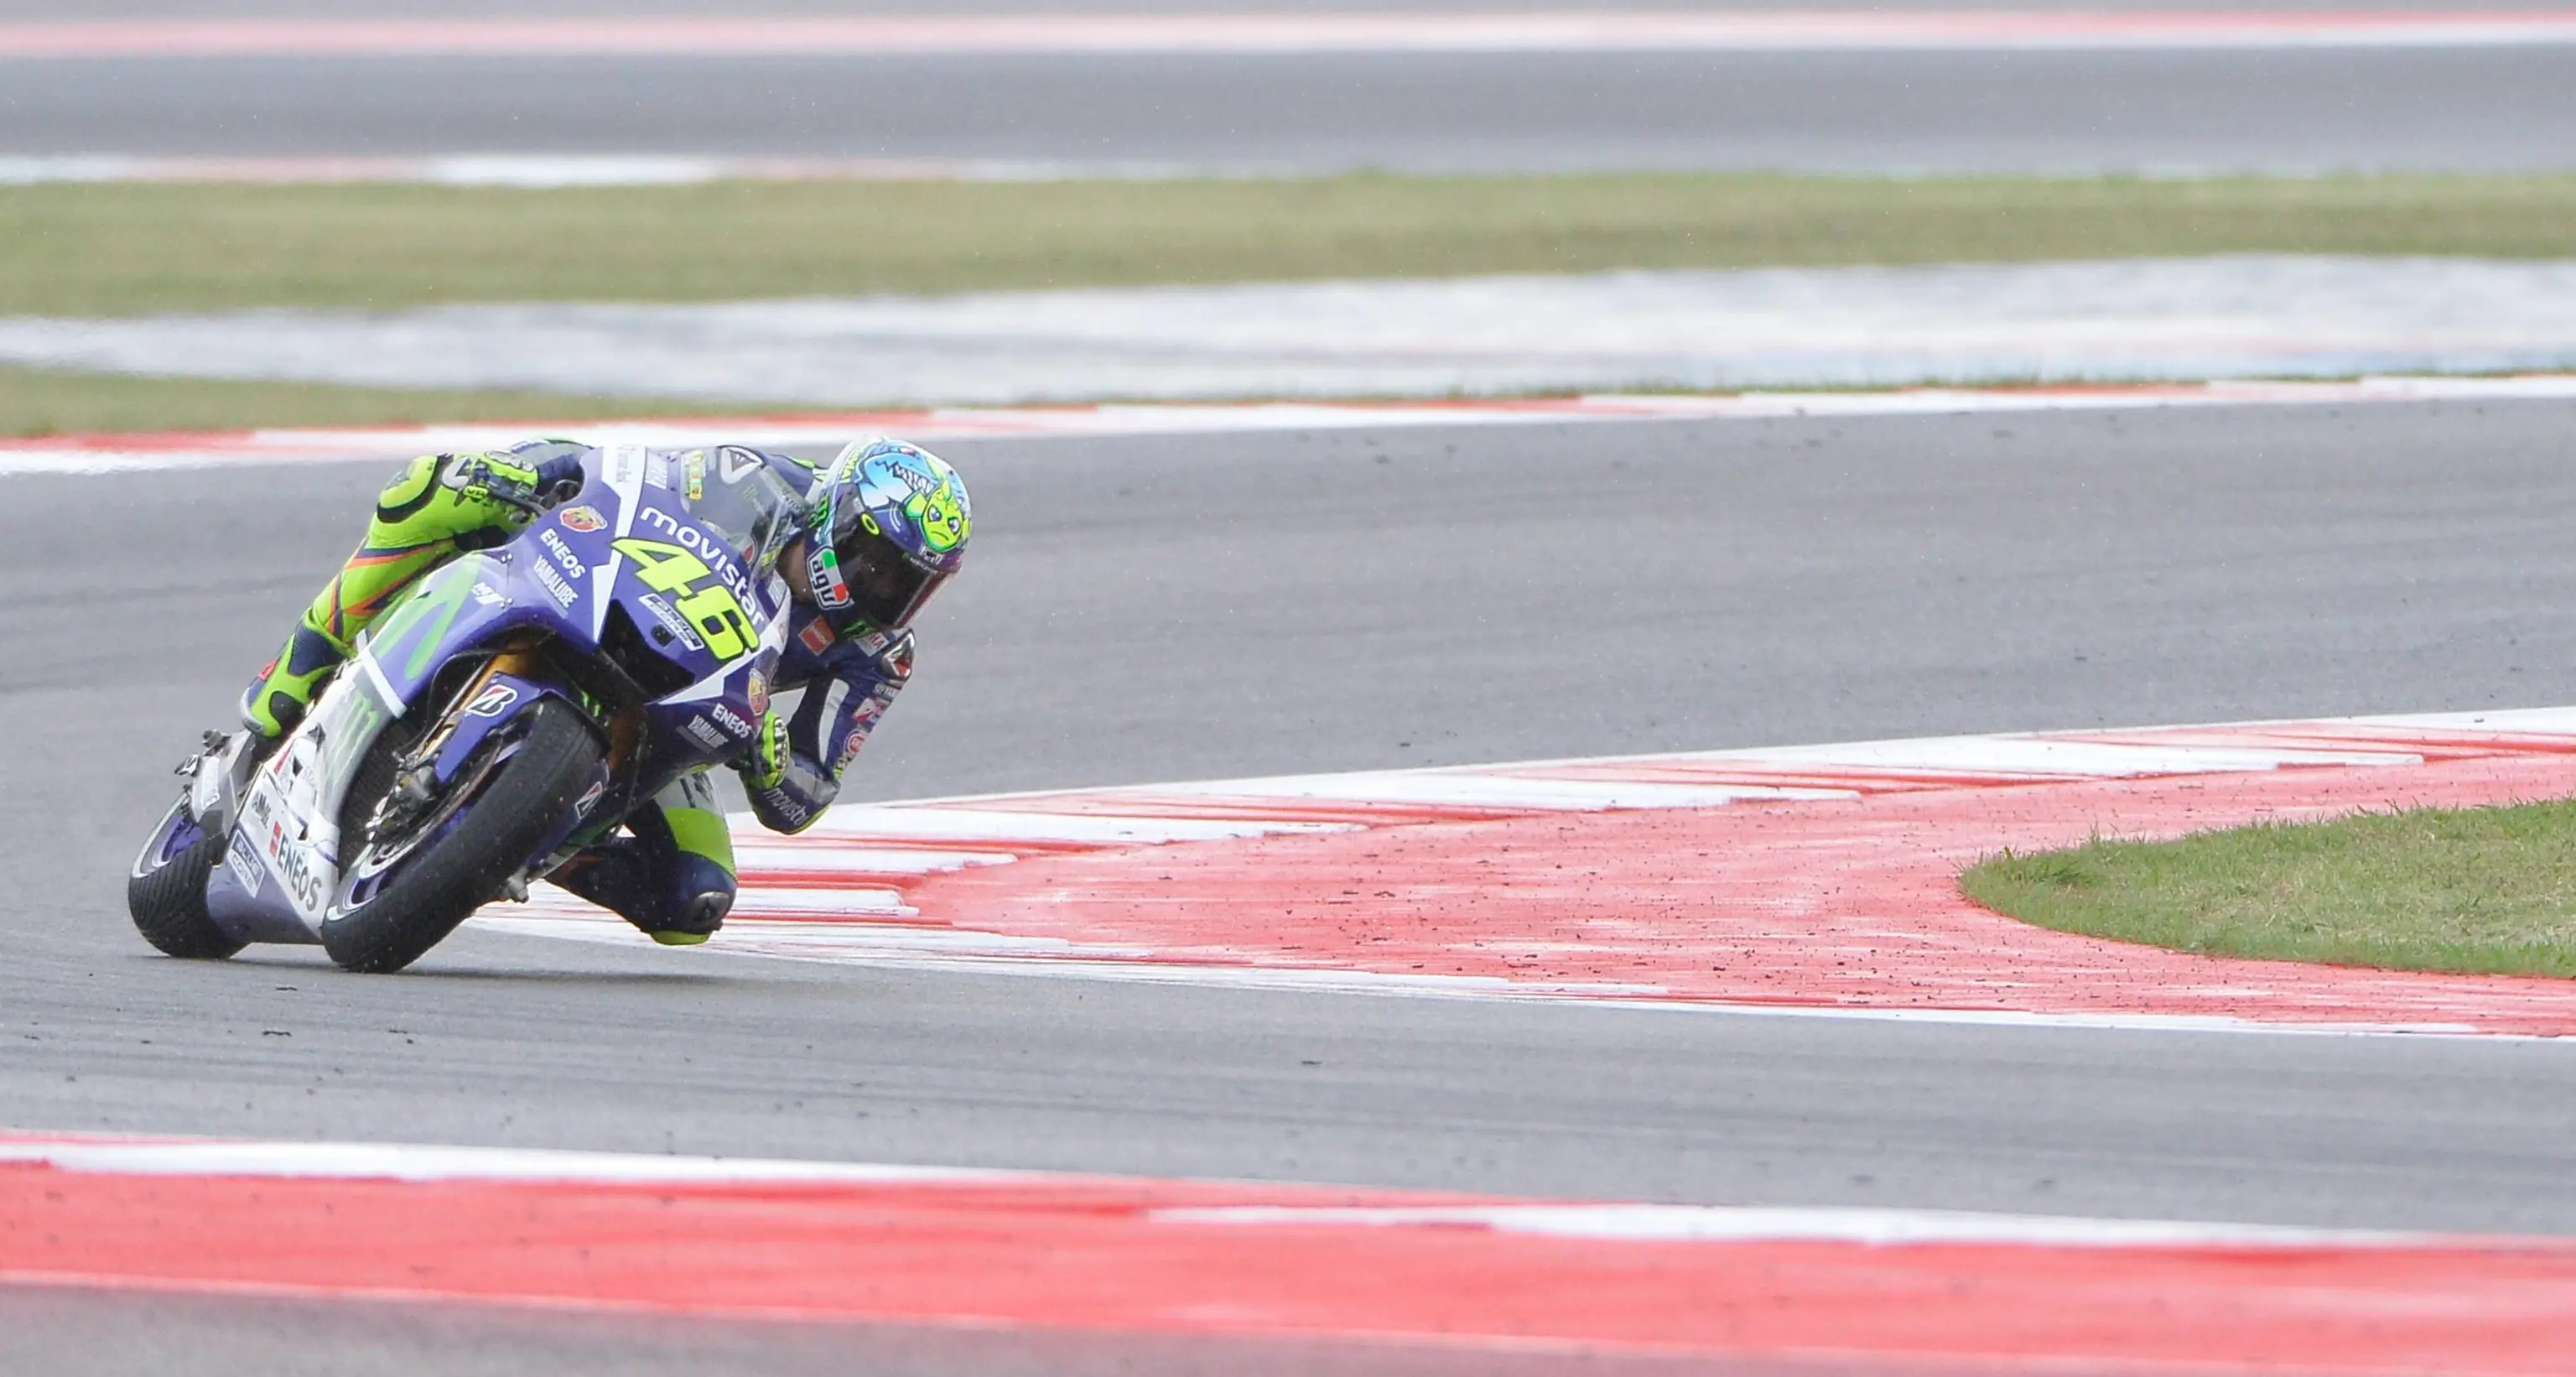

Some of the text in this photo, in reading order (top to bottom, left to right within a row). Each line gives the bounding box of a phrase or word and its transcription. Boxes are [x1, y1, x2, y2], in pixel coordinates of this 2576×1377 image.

[540, 527, 586, 579] ENEOS
[640, 507, 765, 624] movistar
[533, 555, 579, 609] YAMALUBE
[610, 536, 761, 661] 46
[812, 559, 836, 602] agv
[711, 702, 752, 738] ENEOS
[277, 833, 323, 912] ENEOS
